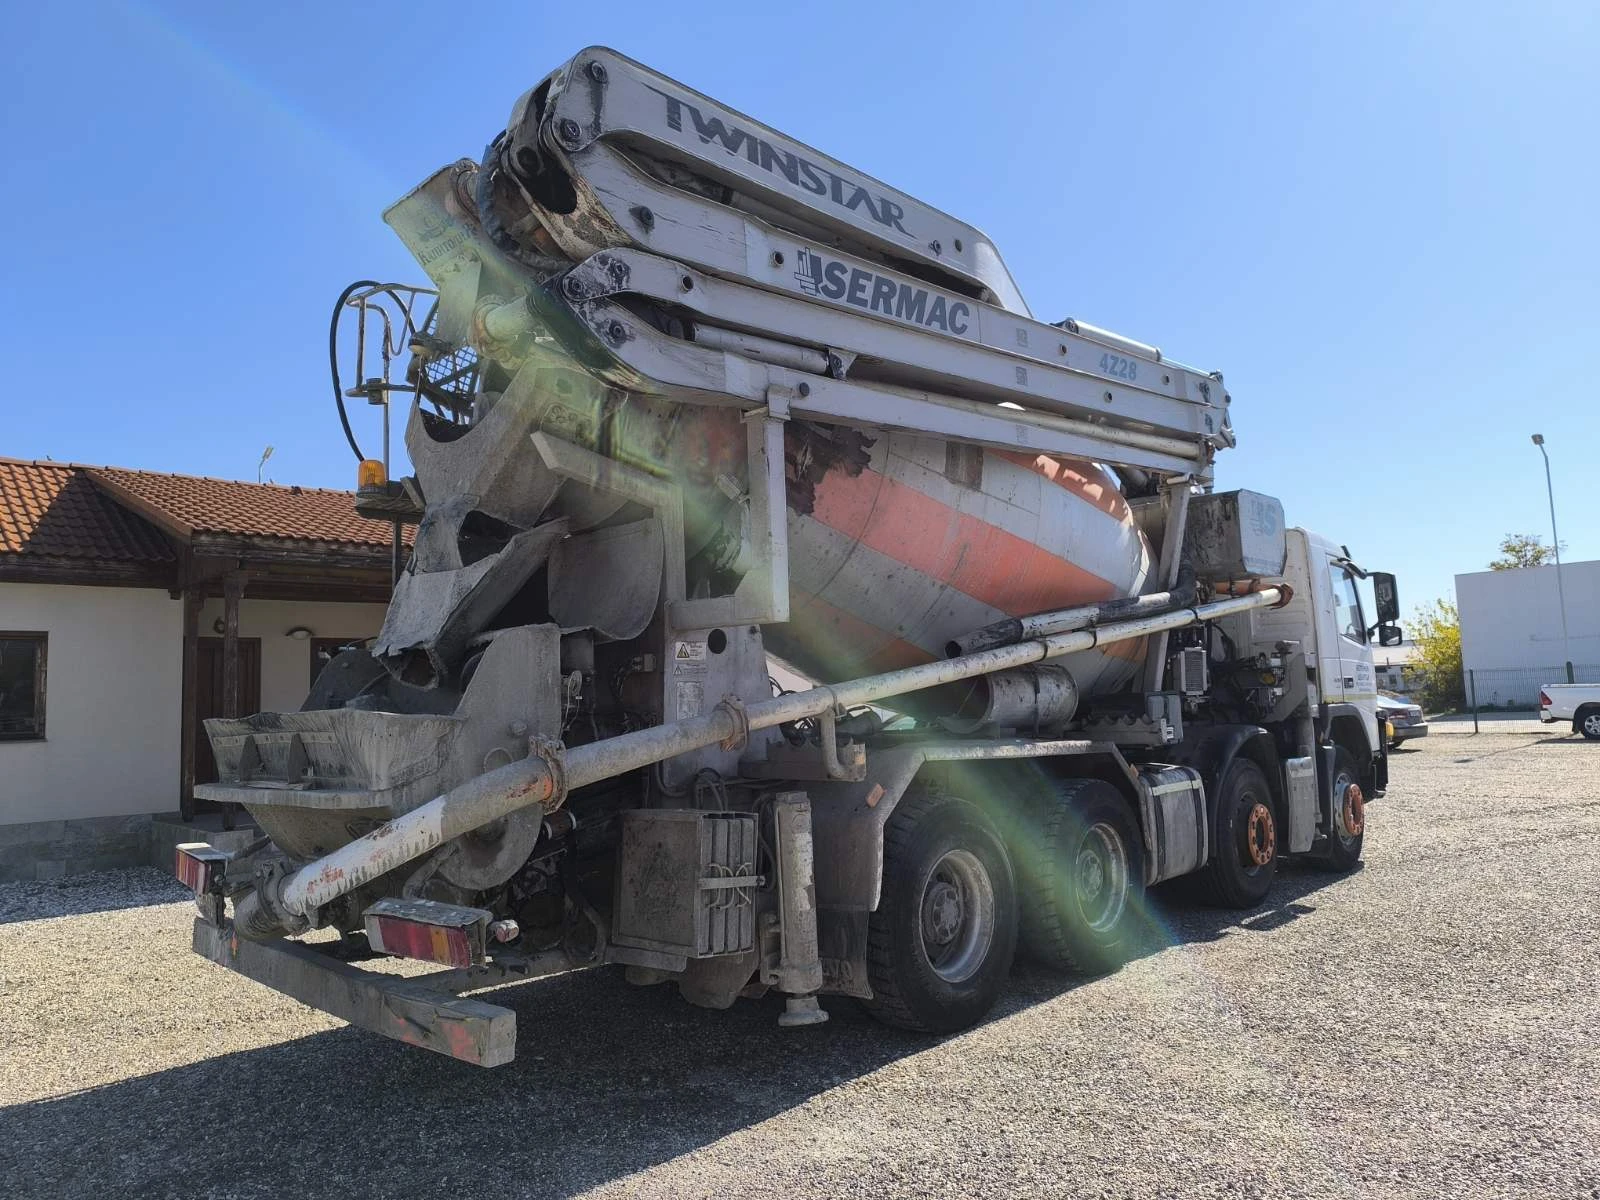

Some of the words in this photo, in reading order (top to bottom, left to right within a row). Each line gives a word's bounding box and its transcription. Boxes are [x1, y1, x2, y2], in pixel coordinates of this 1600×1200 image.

[642, 83, 920, 241] TWINSTAR
[818, 257, 971, 335] SERMAC
[1100, 353, 1137, 381] 4Z28
